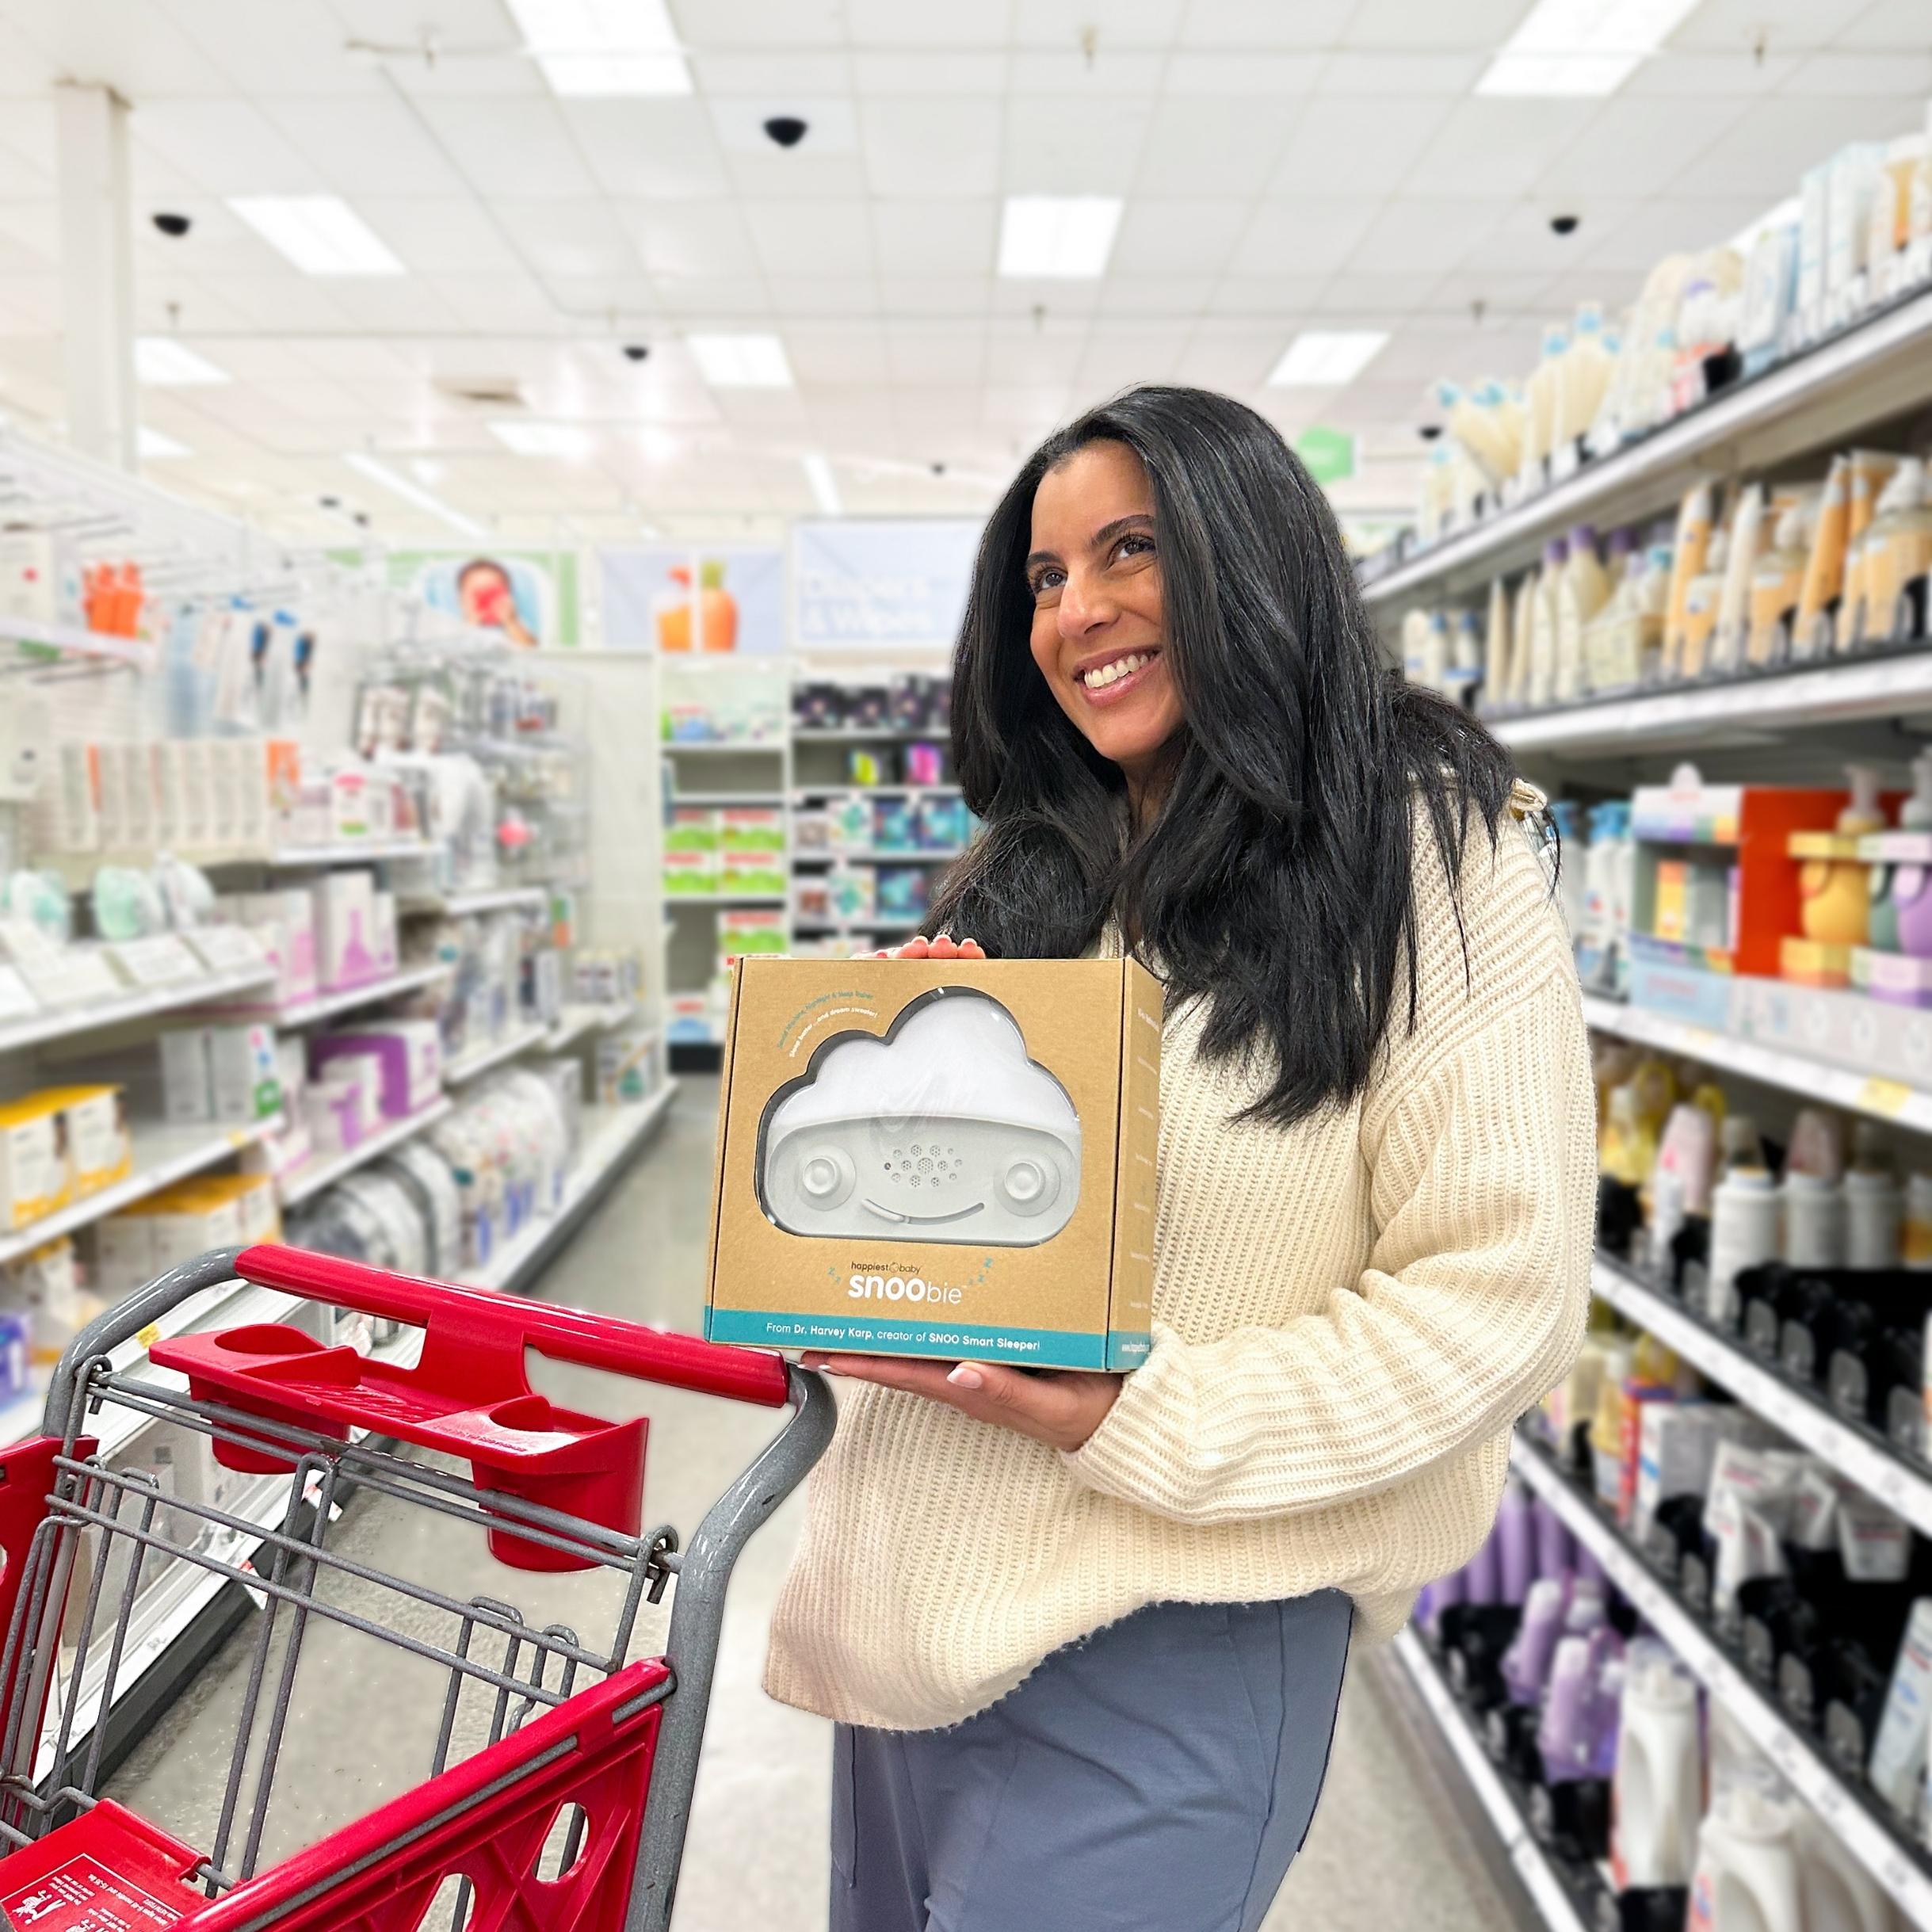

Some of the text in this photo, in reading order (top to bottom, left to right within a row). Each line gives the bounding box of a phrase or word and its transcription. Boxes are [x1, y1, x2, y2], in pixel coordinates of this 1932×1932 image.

[766, 1323, 791, 1332] From
[794, 1324, 807, 1334] Dr.
[811, 1325, 845, 1338] Harvey
[877, 1330, 913, 1341] creator
[916, 1332, 926, 1341] of
[929, 1332, 960, 1344] SNOO
[963, 1335, 994, 1347] Smart
[997, 1338, 1040, 1352] Sleeper!
